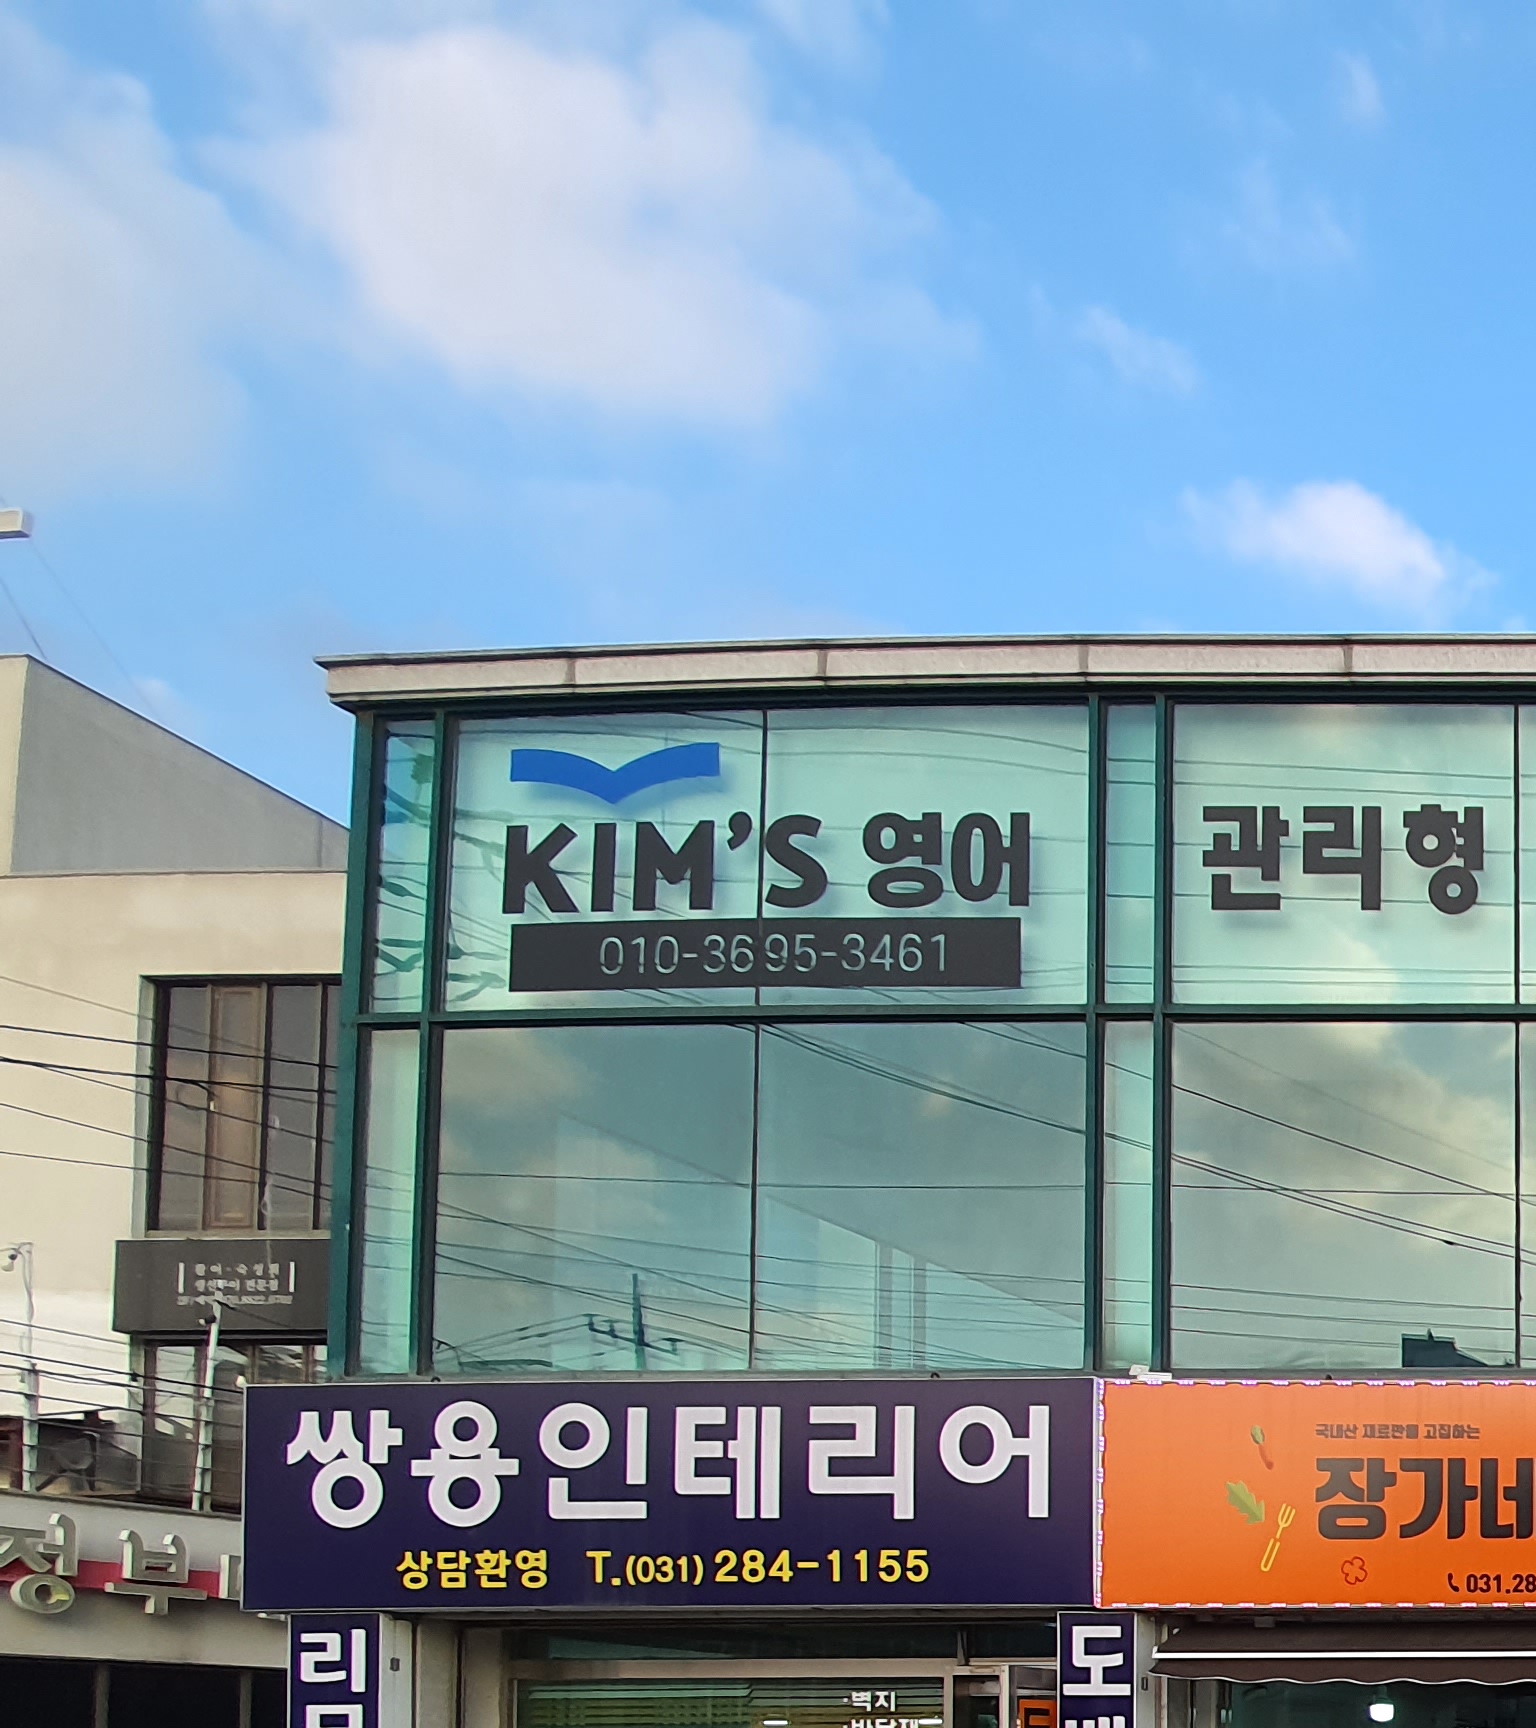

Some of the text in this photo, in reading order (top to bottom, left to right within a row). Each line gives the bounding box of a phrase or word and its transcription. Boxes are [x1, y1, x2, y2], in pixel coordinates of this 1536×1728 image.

[502, 811, 1030, 914] KIM'S 영어
[1203, 804, 1484, 915] 관리형
[600, 933, 948, 975] 010-3695-3461
[286, 1400, 1050, 1528] 쌍용인테리어
[1315, 1424, 1358, 1439] 국내산
[0, 1512, 241, 1616] 정부
[396, 1549, 549, 1590] 상담환영
[851, 1691, 896, 1712] 벽지
